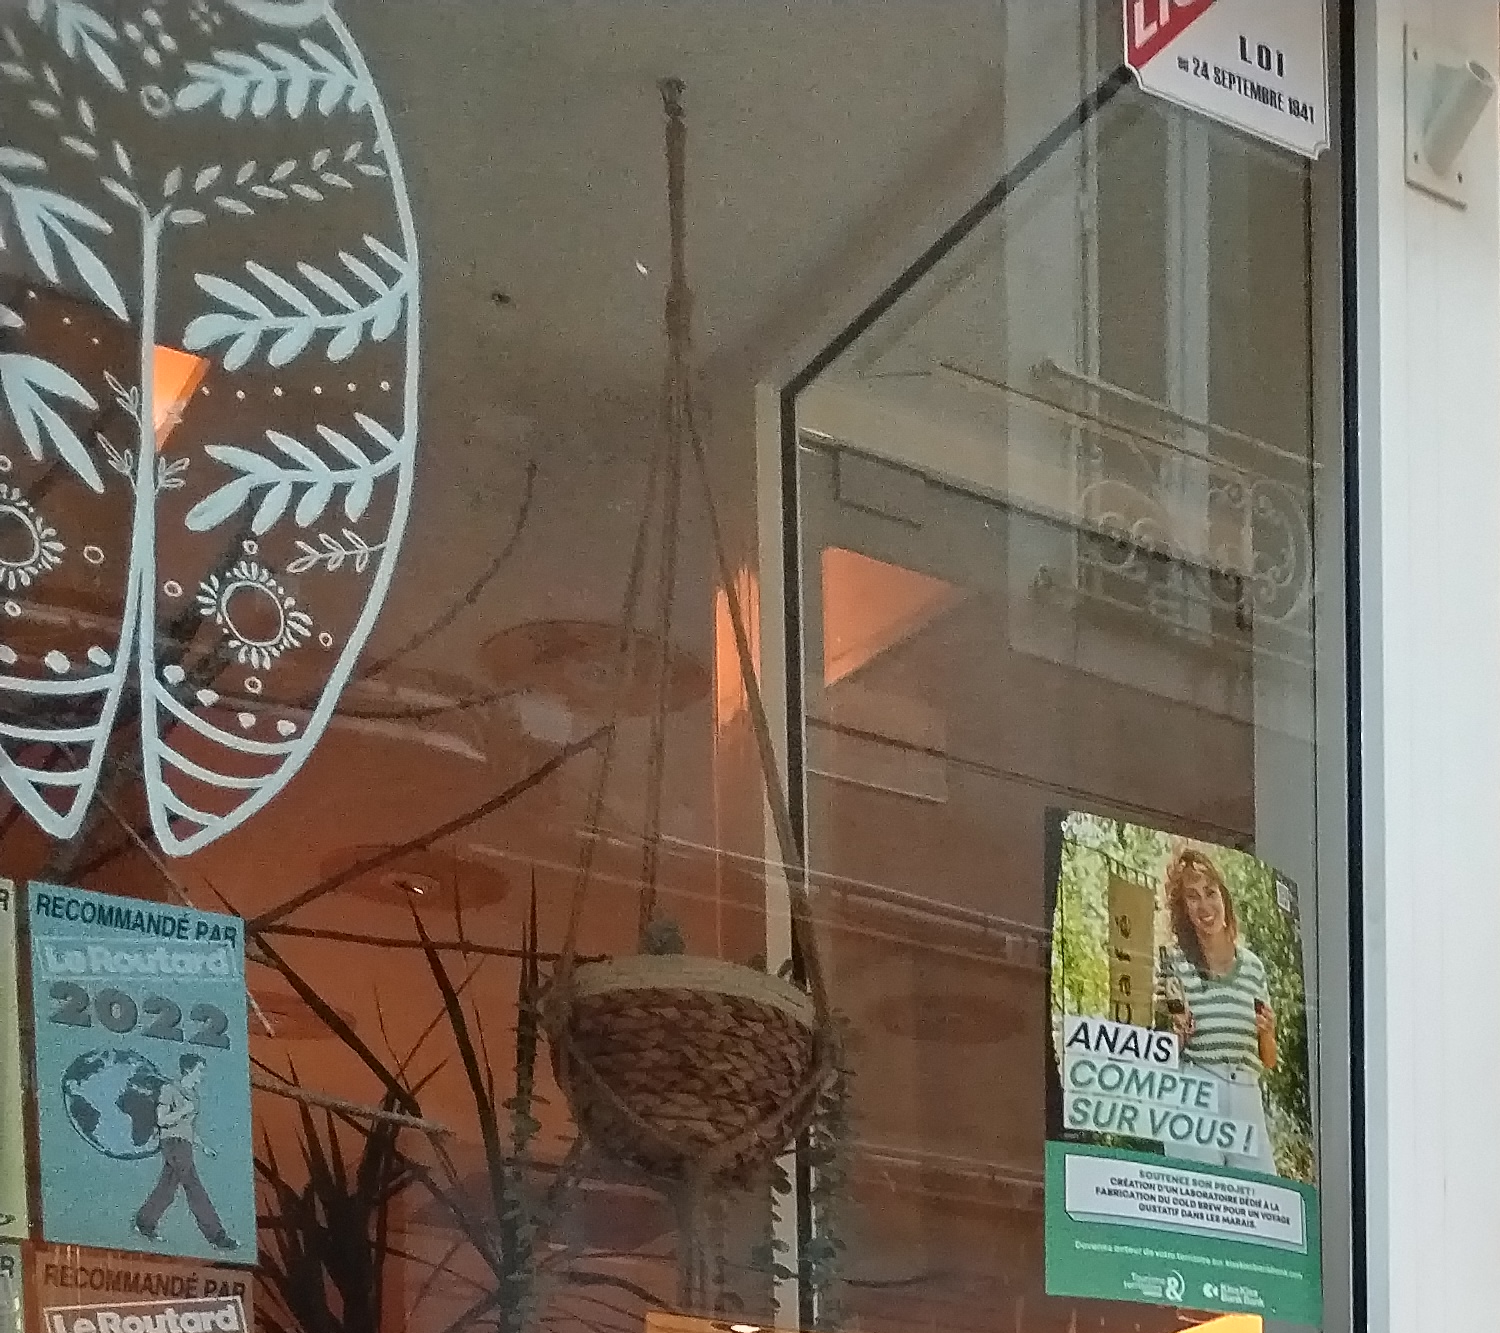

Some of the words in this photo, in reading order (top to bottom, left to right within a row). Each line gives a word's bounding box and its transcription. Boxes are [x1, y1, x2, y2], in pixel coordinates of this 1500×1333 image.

[1238, 34, 1284, 78] LOI
[1192, 56, 1210, 81] 24
[1213, 65, 1285, 113] SEPTEMBRE
[36, 892, 191, 939] RECOMMANDÉ
[194, 921, 238, 949] PAR
[49, 981, 231, 1051] 2022
[1069, 1059, 1214, 1109] COMPTE
[1068, 1097, 1140, 1133] SUR
[43, 1262, 200, 1299] RECOMMANDÉ
[203, 1281, 247, 1302] PAR
